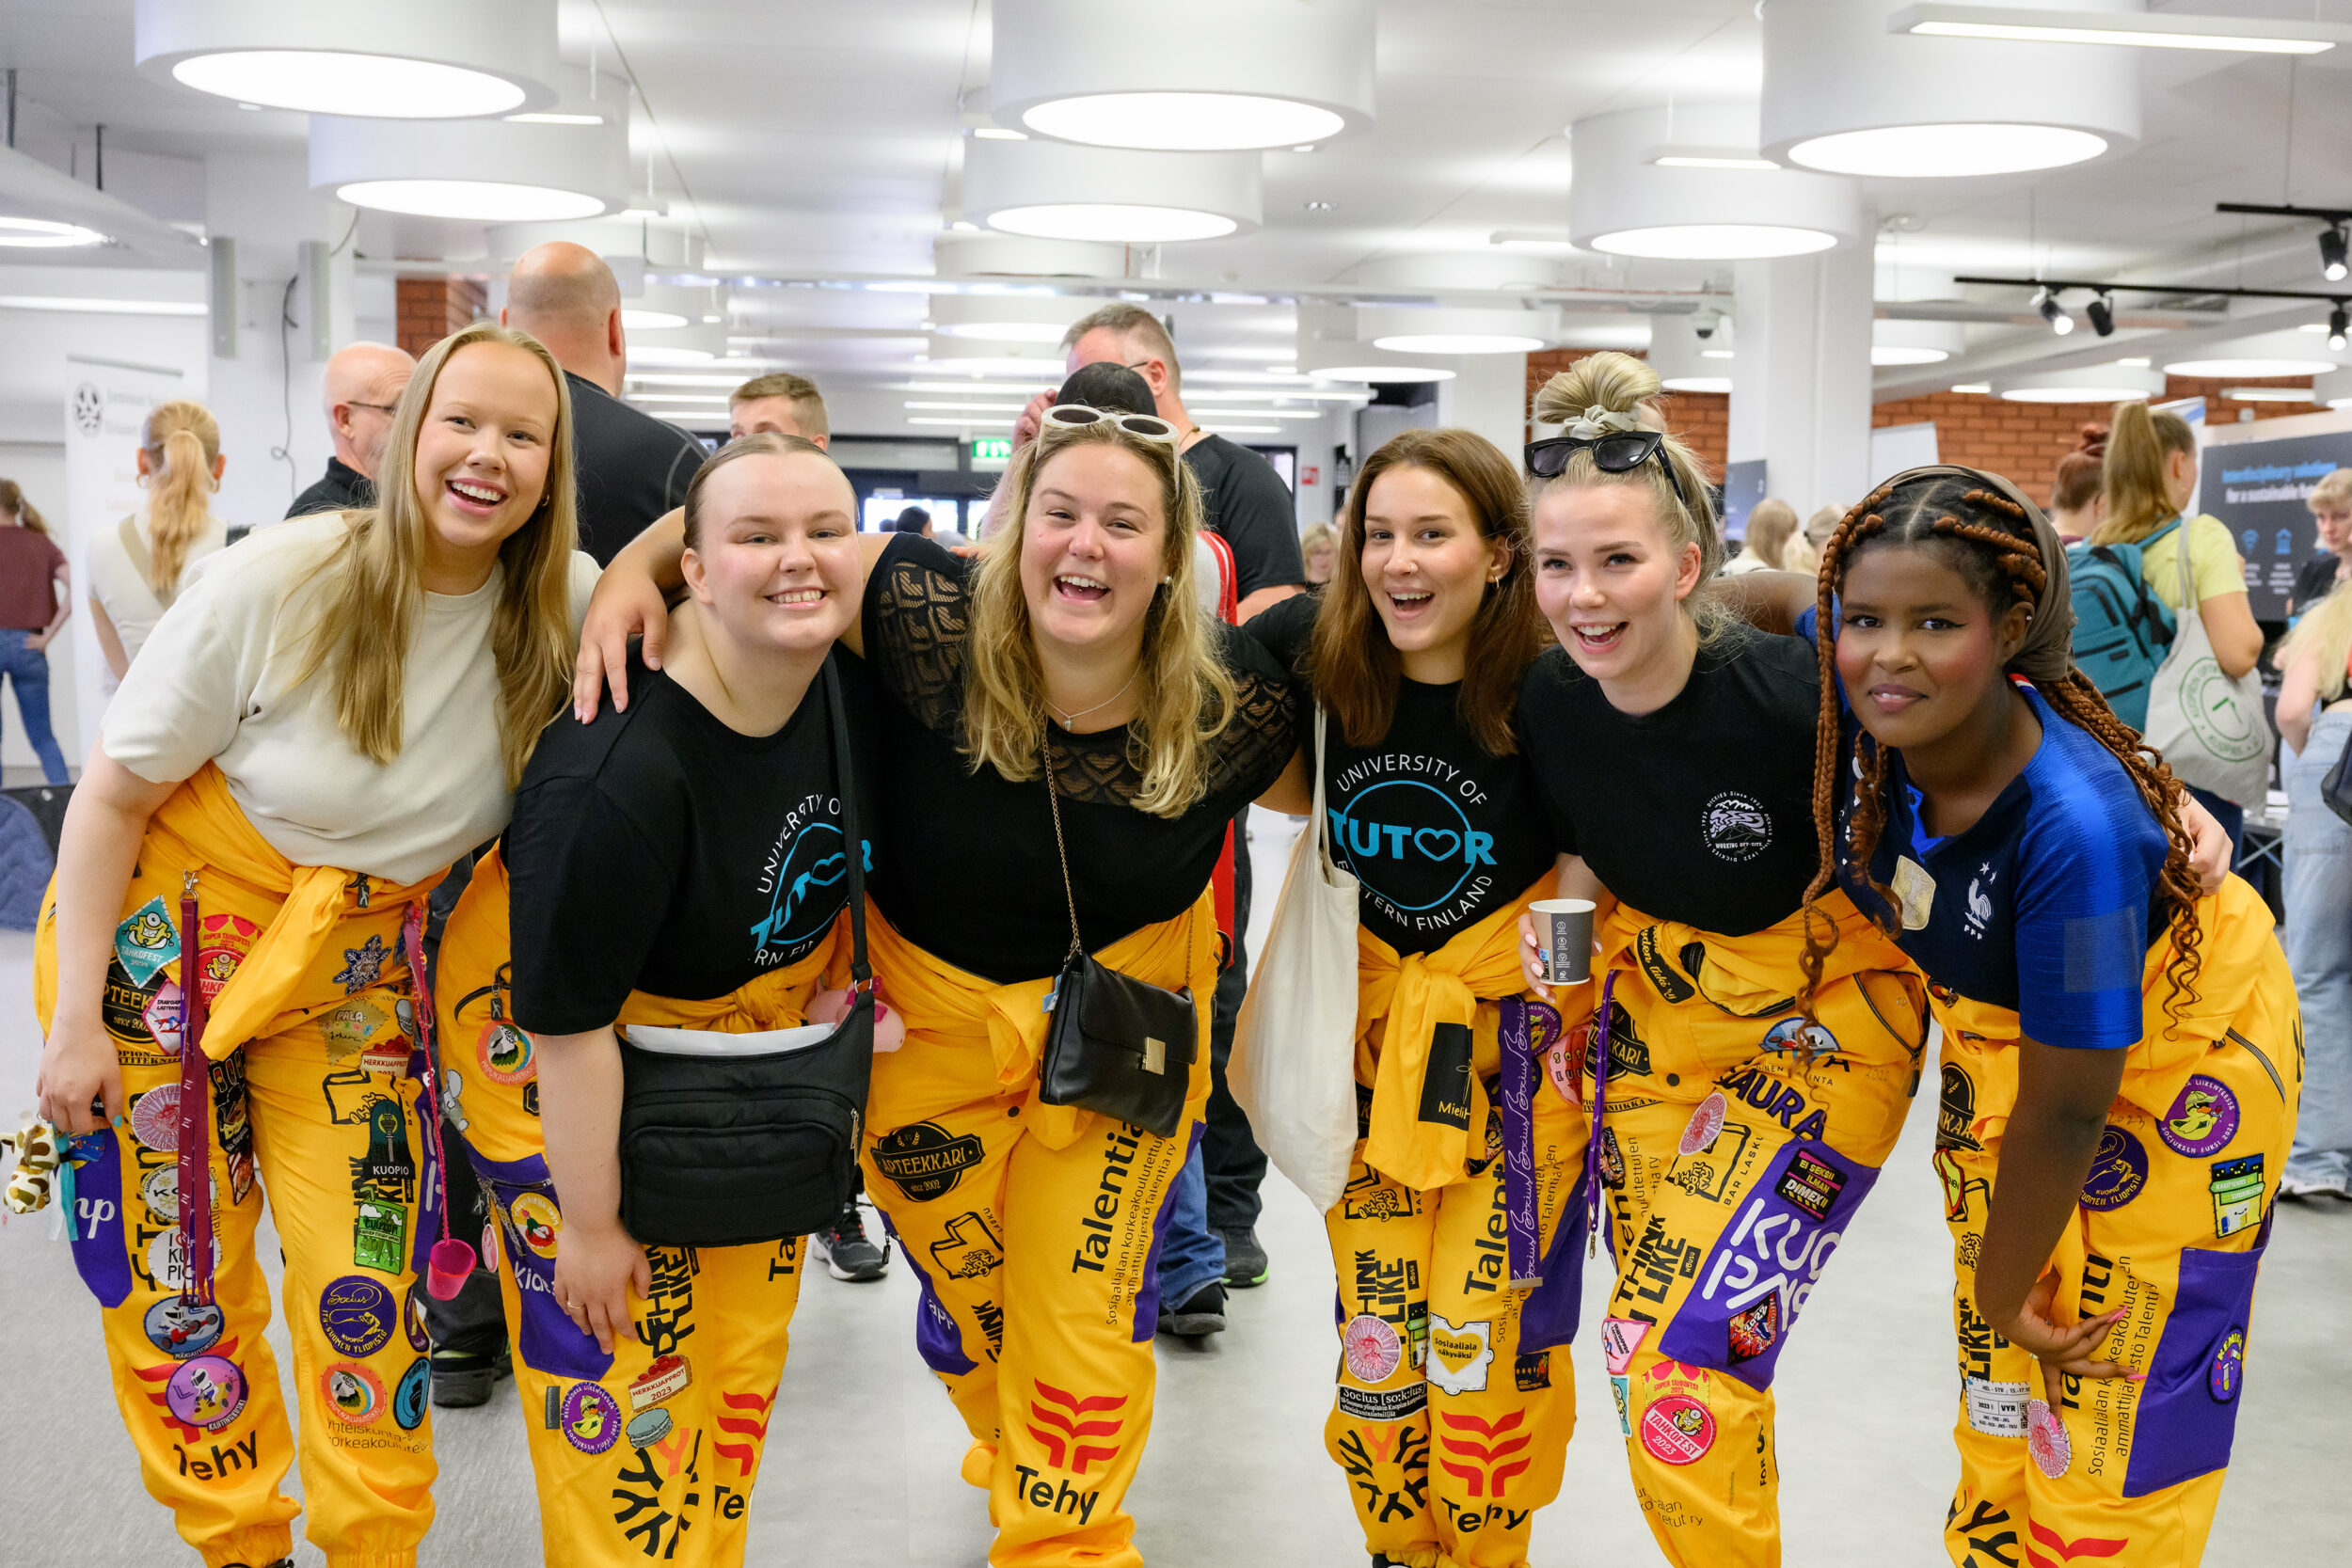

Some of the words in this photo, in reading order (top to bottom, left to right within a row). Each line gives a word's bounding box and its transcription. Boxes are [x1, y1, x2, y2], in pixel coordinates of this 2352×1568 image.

[1336, 753, 1461, 792] UNIVERSITY
[1459, 780, 1487, 805] OF
[1337, 860, 1408, 927] ETERN
[1416, 875, 1493, 930] FINLAND
[120, 945, 165, 963] TAHKOFEST
[481, 1059, 537, 1083] PAPUKAIJAMERKK
[373, 1165, 409, 1177] KUOPIO
[882, 1146, 965, 1175] APTEEKKARI
[1799, 1158, 1808, 1169] EI
[1808, 1163, 1836, 1181] SEKSII
[1146, 1158, 1172, 1206] Talentia
[1724, 1180, 1741, 1206] BAR
[1805, 1174, 1831, 1195] ILMAN
[2110, 1175, 2142, 1204] YLIOPISTO
[1072, 1121, 1148, 1275] Talentia
[1105, 1250, 1130, 1325] Sosiaalialan
[1120, 1134, 1168, 1248] korkeakoulutettuj
[1355, 1248, 1377, 1318] HINK
[1636, 1236, 1687, 1305] LIKE
[1375, 1257, 1406, 1324] LIKE
[1742, 1304, 1768, 1332] 2022
[174, 1332, 222, 1360] MÄKIAUTOKUSKI
[353, 1330, 388, 1354] YLIOPISTO
[1435, 1337, 1478, 1352] Sosiaaliala
[1438, 1348, 1473, 1360] näkyväksi
[632, 1368, 685, 1397] HERKKUAPPROT
[650, 1386, 673, 1402] 2023
[1343, 1386, 1379, 1404] Socius
[1653, 1381, 1671, 1392] SUPER
[208, 1399, 246, 1432] KARTINGKUSKI
[1649, 1414, 1701, 1456] TAHKOFEST
[1651, 1434, 1678, 1456] 2023
[2088, 1388, 2111, 1477] Sosiaalialan
[173, 1430, 258, 1481] Tehy
[1015, 1465, 1100, 1526] Tehy
[1440, 1497, 1530, 1533] Tehy
